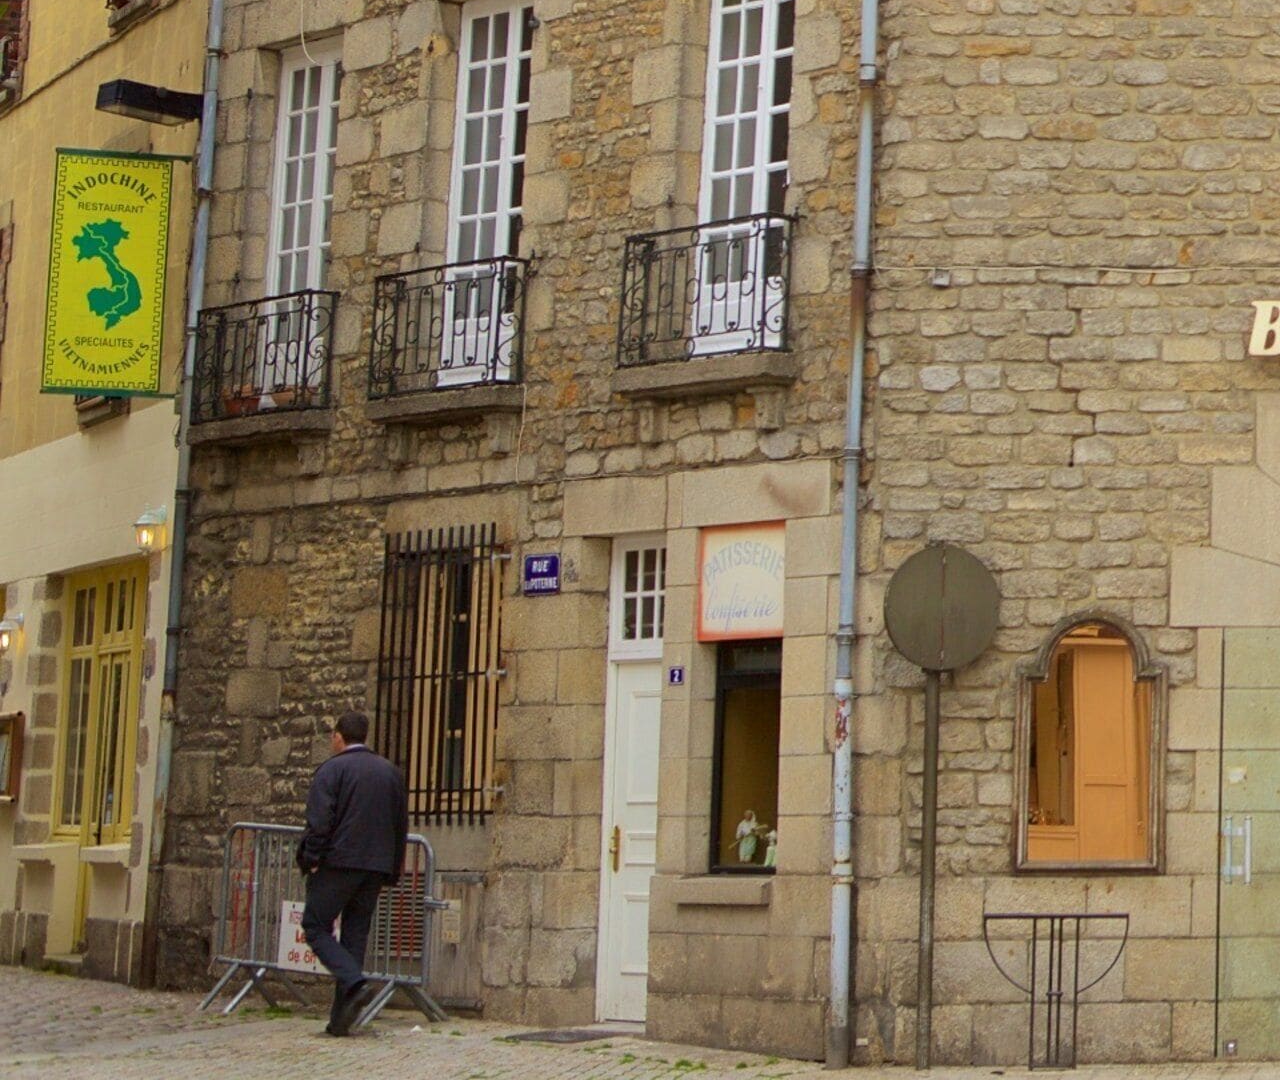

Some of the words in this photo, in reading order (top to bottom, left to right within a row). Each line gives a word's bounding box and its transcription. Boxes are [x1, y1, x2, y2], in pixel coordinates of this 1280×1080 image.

[66, 172, 157, 205] INDOCHINE
[78, 201, 145, 214] RESTAURANT
[74, 336, 134, 349] SPECIALITES
[58, 338, 150, 375] VIETNAMIENNES
[532, 560, 549, 573] RUE
[704, 540, 785, 586] PATISSERIE
[673, 670, 680, 682] 2
